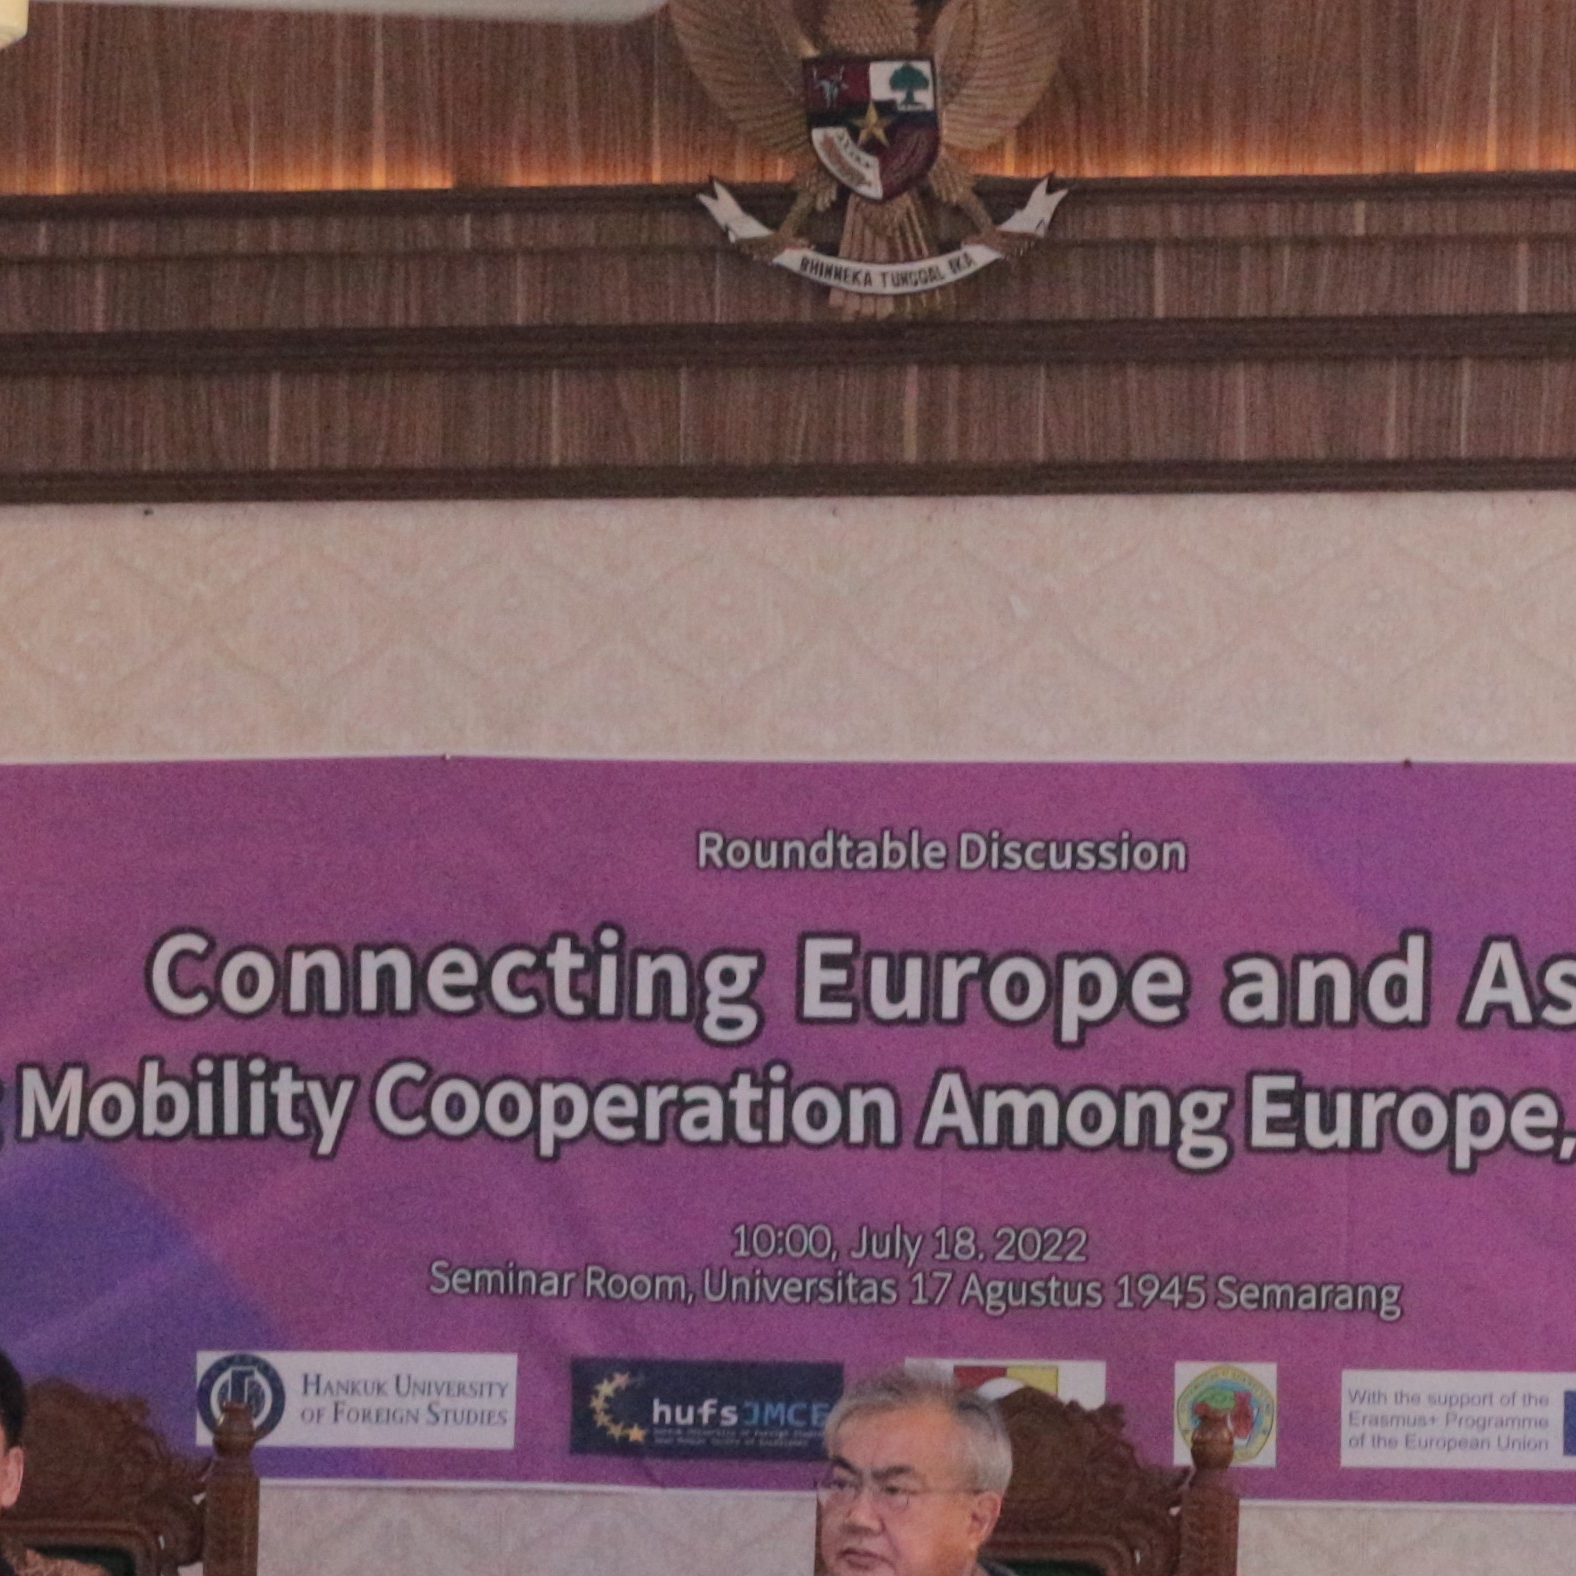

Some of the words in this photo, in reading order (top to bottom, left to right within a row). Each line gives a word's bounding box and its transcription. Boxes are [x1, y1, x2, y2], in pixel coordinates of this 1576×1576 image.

[800, 255, 873, 288] BHINNEKA
[881, 264, 945, 288] TUNGGAL
[696, 829, 947, 871] Roundtable
[959, 831, 1189, 872] Discussion
[149, 926, 761, 1044] Connecting
[798, 933, 1188, 1047] Europe
[1224, 931, 1427, 1027] and
[18, 1056, 355, 1157] Mobility
[371, 1059, 898, 1159] Cooperation
[920, 1070, 1231, 1171] Among
[732, 1222, 840, 1262] 10:00,
[850, 1225, 923, 1268] July
[995, 1226, 1088, 1263] 2022
[429, 1260, 575, 1297] Seminar
[585, 1266, 696, 1305] Room,
[704, 1268, 898, 1306] Universitas
[911, 1271, 954, 1306] 17
[960, 1272, 1104, 1315] Agustus
[1115, 1273, 1207, 1310] 1945
[1215, 1275, 1403, 1322] Semarang
[1347, 1389, 1388, 1406] With
[1394, 1389, 1421, 1407] the
[1427, 1391, 1494, 1410] support
[1499, 1391, 1519, 1408] of
[1522, 1391, 1550, 1408] the
[1348, 1411, 1438, 1429] Erasmus+
[1444, 1412, 1550, 1433] Programme
[1348, 1432, 1367, 1450] of
[1371, 1433, 1398, 1450] the
[1404, 1434, 1491, 1454] European
[1496, 1434, 1550, 1452] Union
